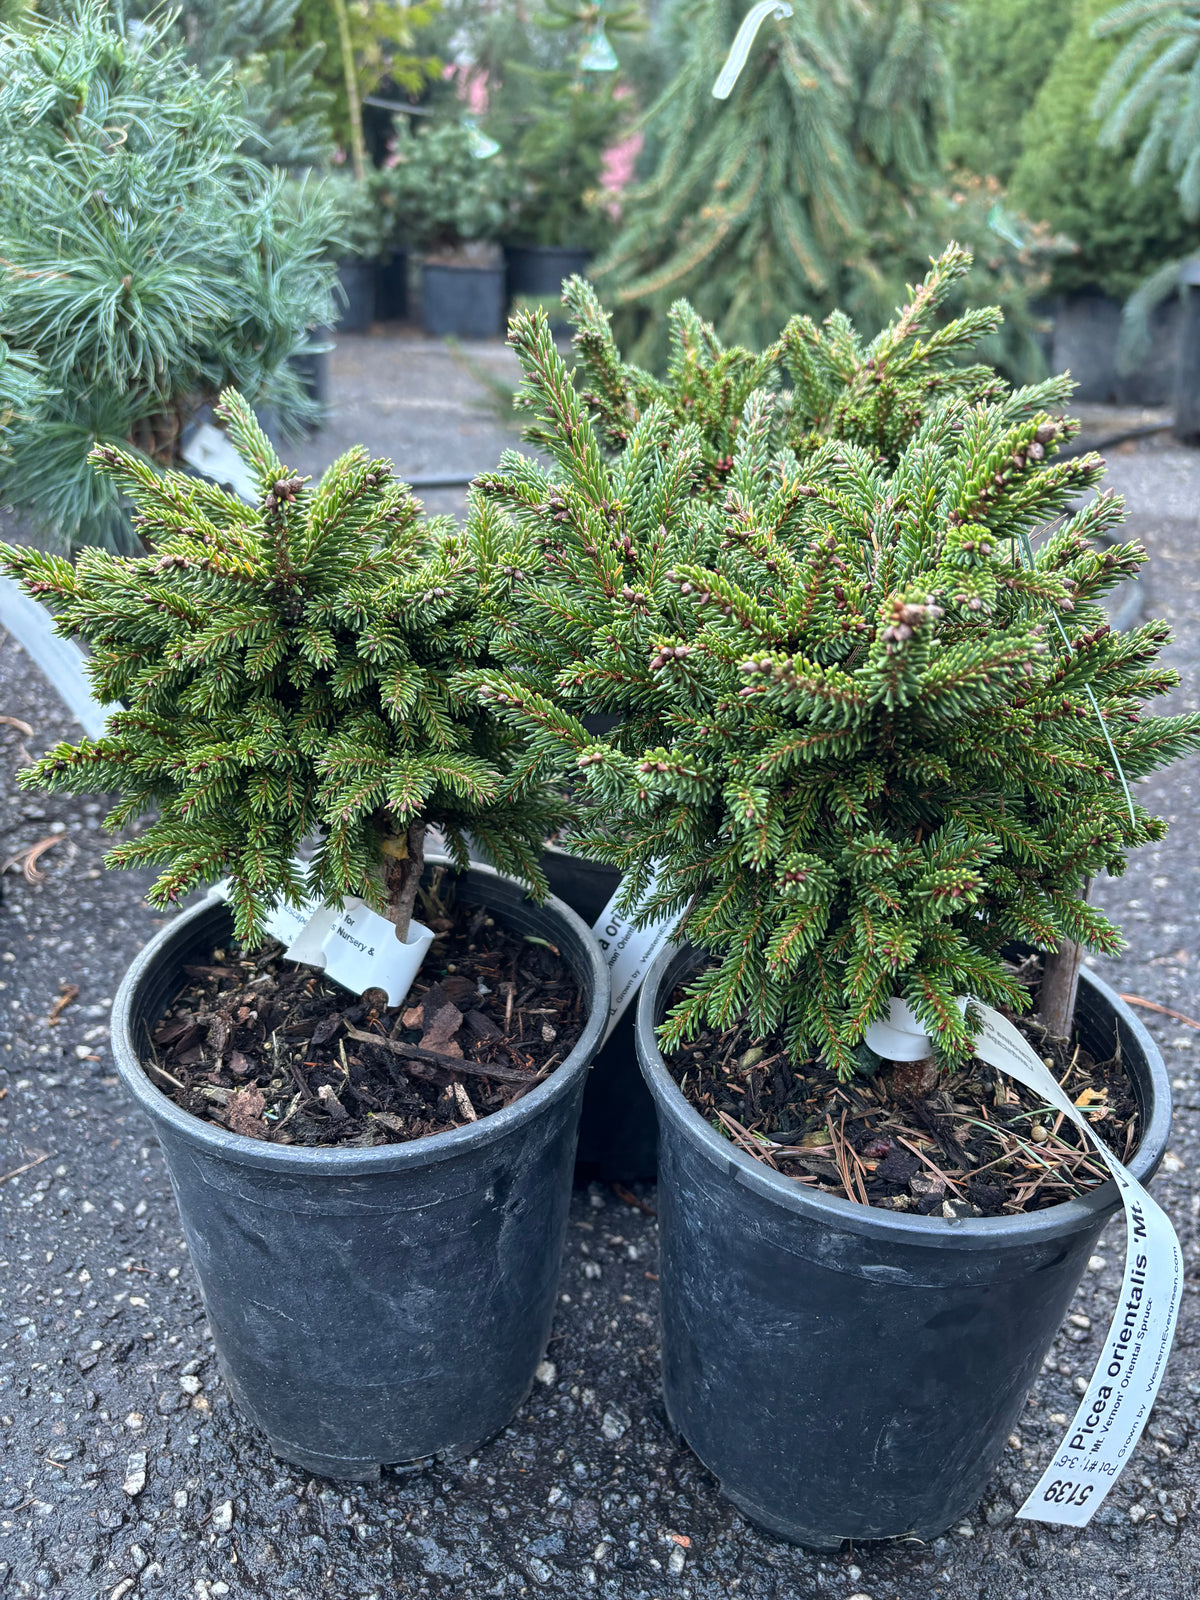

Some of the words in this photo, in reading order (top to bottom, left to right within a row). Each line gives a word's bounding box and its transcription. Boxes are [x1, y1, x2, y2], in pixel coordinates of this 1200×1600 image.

[344, 914, 355, 926] for
[336, 926, 367, 952] Nursery
[367, 947, 376, 956] &
[1068, 1385, 1113, 1451] Picea
[1107, 1253, 1148, 1378] orientalis
[1117, 1421, 1139, 1458] Grown
[1136, 1404, 1146, 1418] by
[1146, 1246, 1179, 1393] WesternEvergreen.com
[1100, 1391, 1124, 1433] Vernon'
[1121, 1343, 1142, 1388] Oriental
[1099, 1462, 1118, 1476] Pot
[1043, 1479, 1094, 1506] 5139
